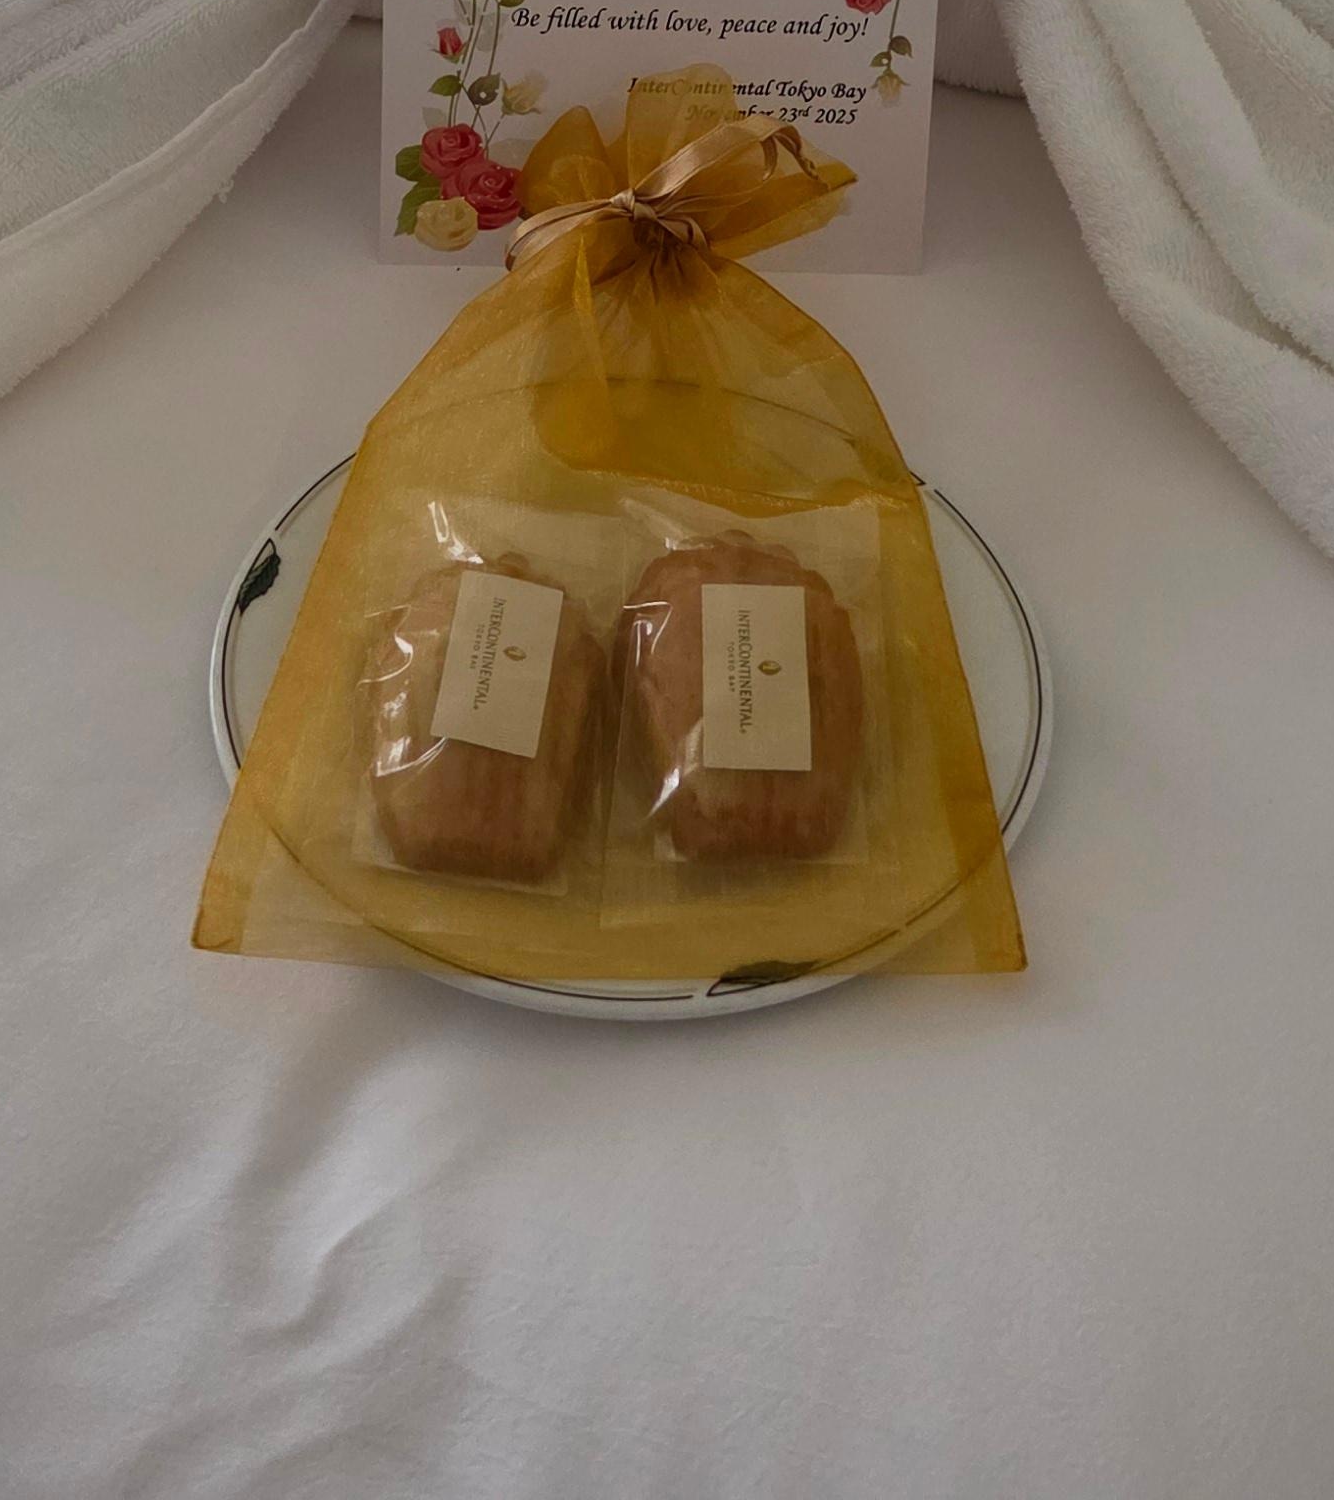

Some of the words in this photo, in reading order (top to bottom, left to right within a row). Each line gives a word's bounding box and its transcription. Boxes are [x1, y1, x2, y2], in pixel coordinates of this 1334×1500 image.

[511, 7, 541, 28] Be
[539, 6, 608, 35] filled
[607, 8, 659, 31] with
[665, 9, 713, 36] love,
[718, 17, 778, 40] peace
[783, 13, 829, 35] and
[822, 15, 870, 44] joy!
[775, 79, 827, 103] Tokyo
[831, 82, 868, 105] Bay
[685, 104, 775, 121] Nombr
[814, 108, 859, 125] 2025
